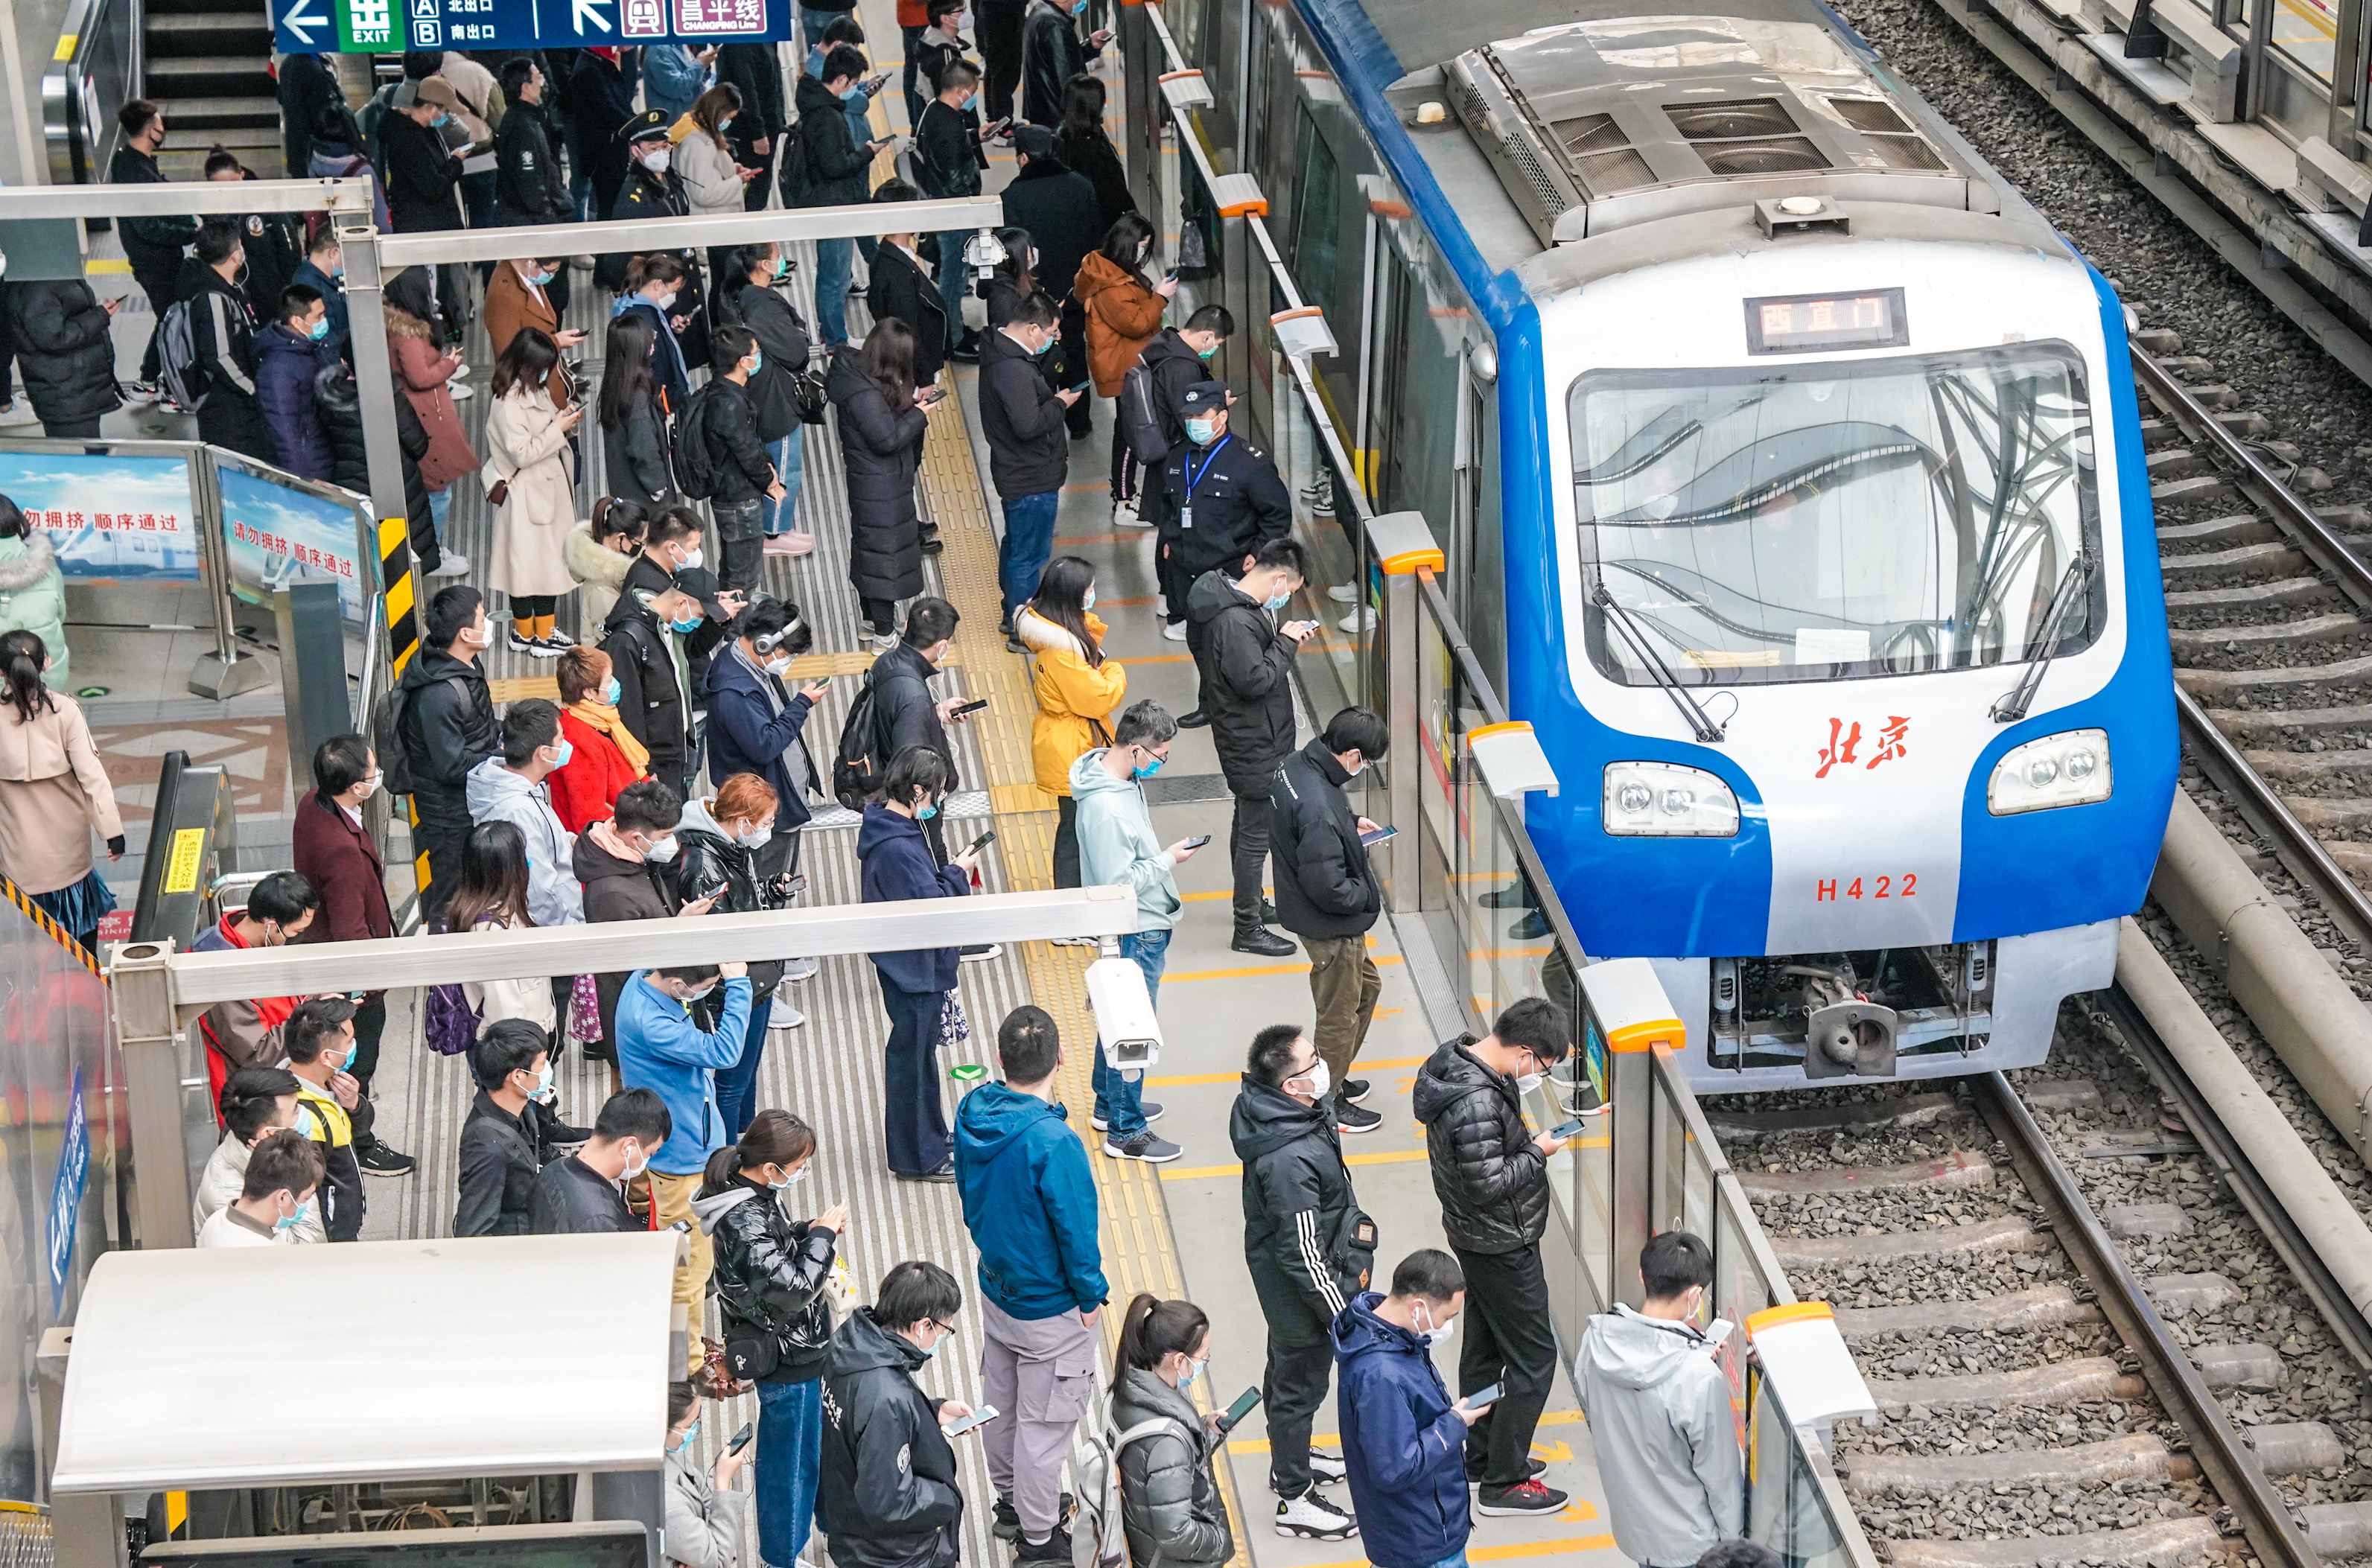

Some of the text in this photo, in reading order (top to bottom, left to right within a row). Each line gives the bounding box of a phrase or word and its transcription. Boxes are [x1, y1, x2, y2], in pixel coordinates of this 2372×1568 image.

[416, 0, 435, 15] A
[448, 0, 493, 13] 北出口
[681, 0, 760, 22] 昌平线
[418, 23, 436, 43] B
[451, 24, 495, 40] 南出口
[682, 20, 757, 31] CHANGPING Line
[352, 30, 390, 43] EXIT
[1762, 298, 1883, 335] 西直门
[94, 513, 179, 532] 顺序通过
[234, 520, 353, 578] 请勿拥挤 顺序通过
[1815, 716, 1912, 779] 北京
[1817, 873, 1917, 902] H422
